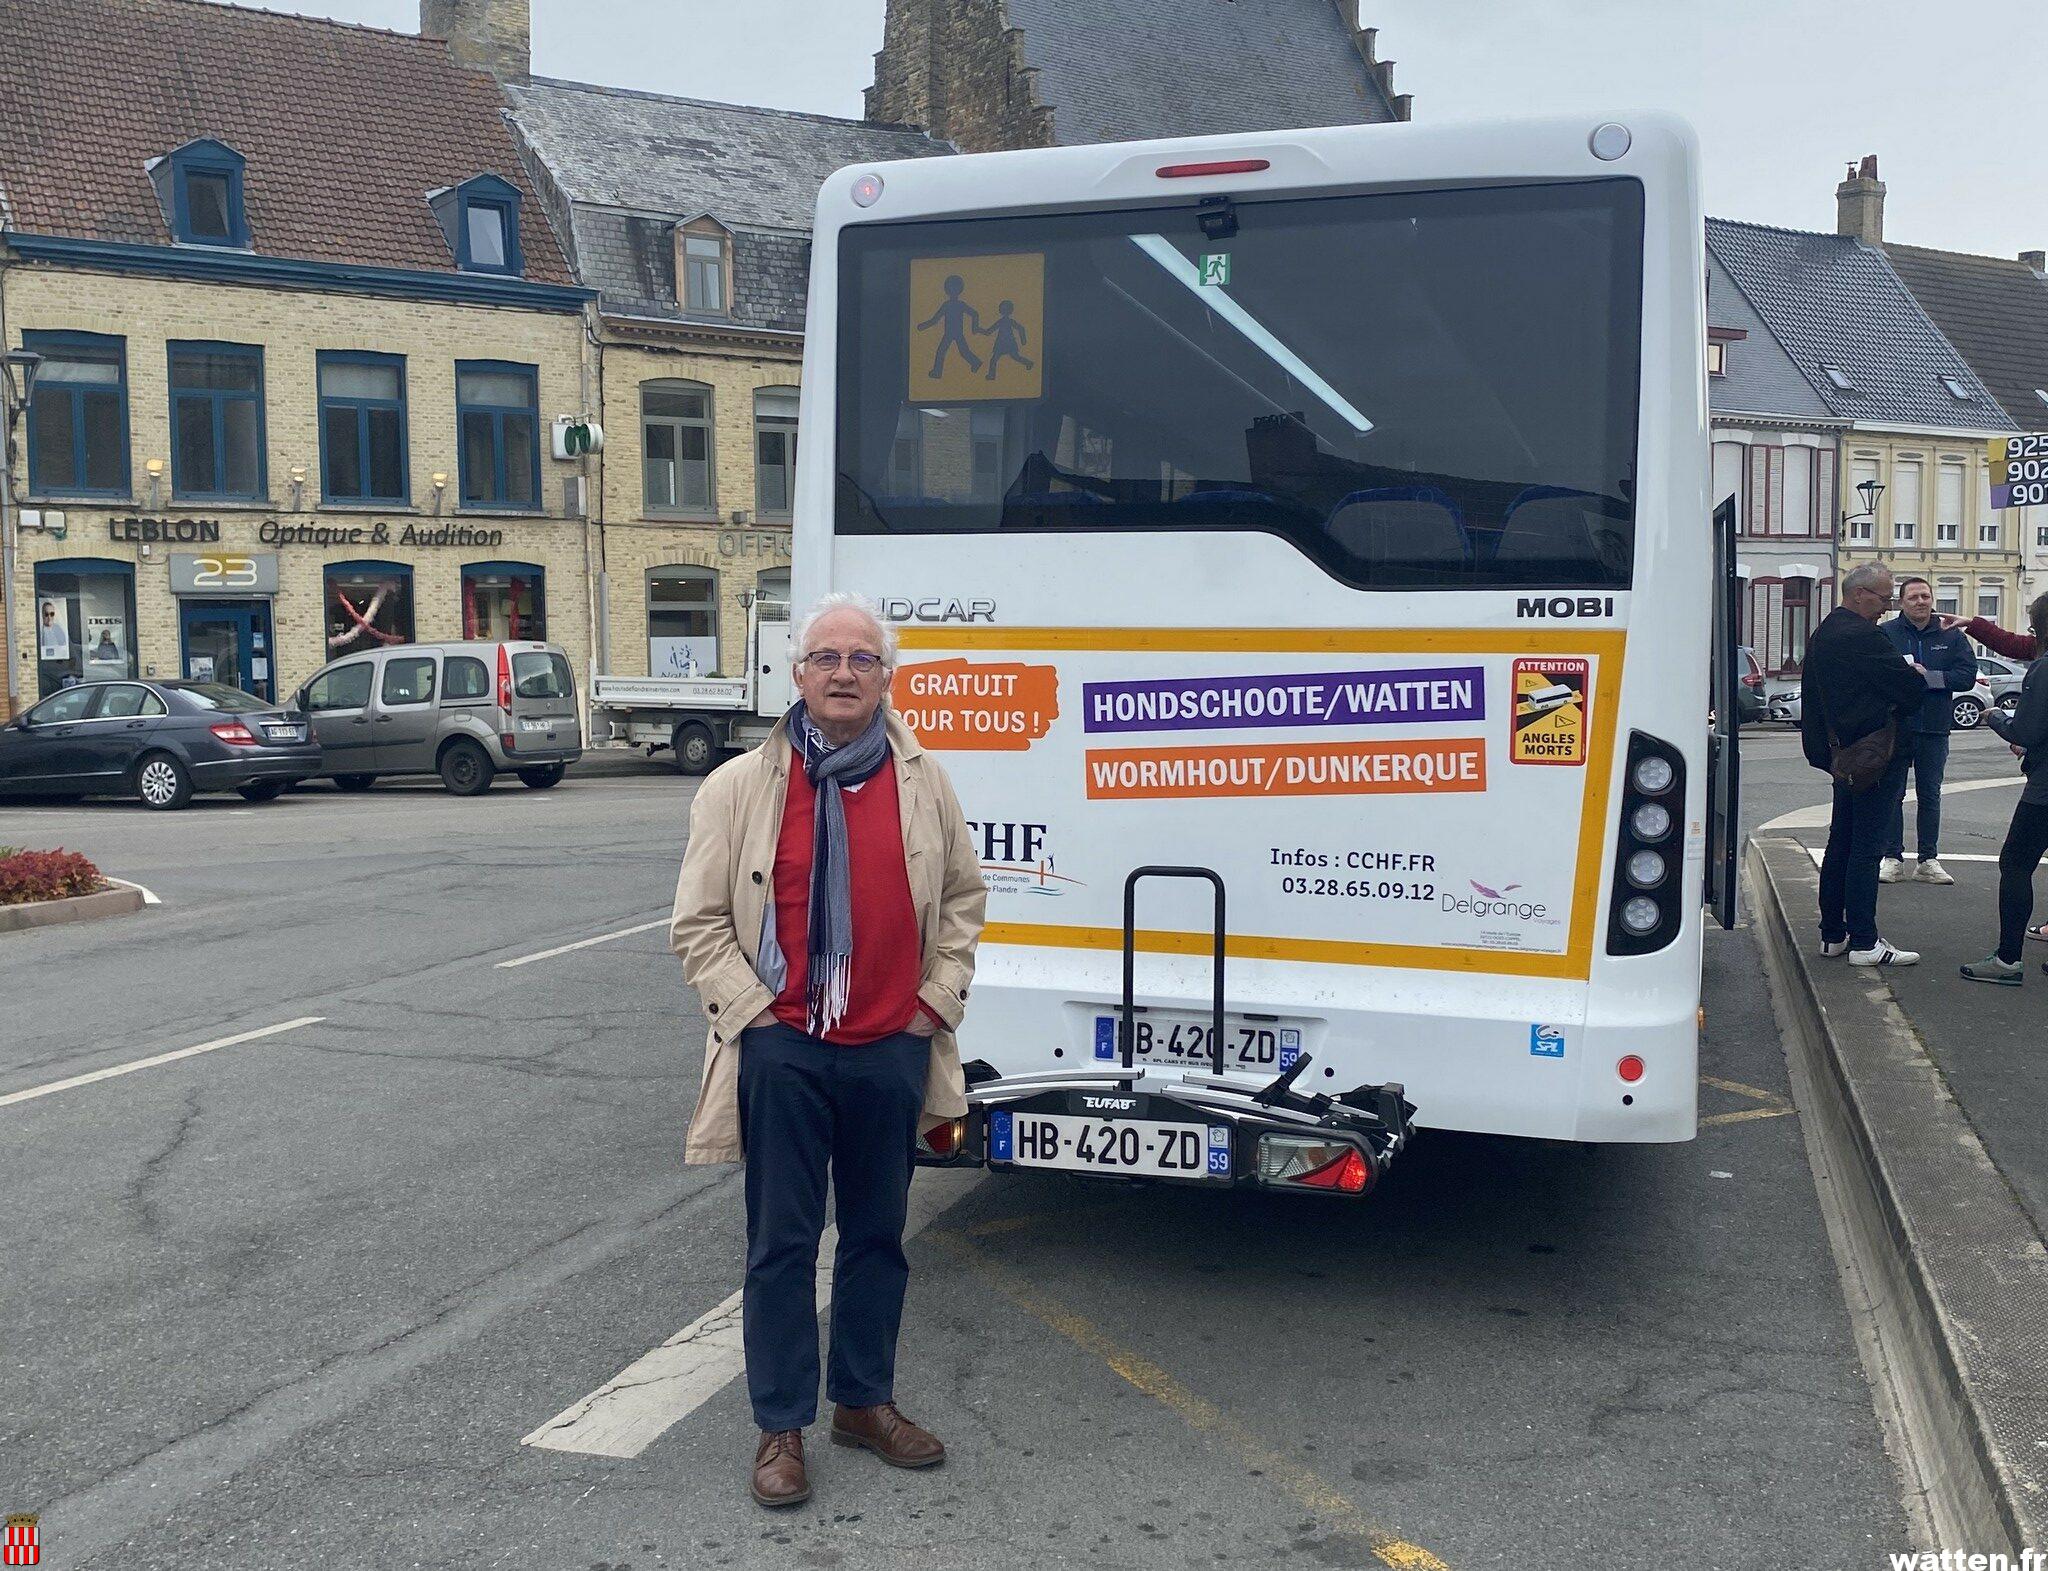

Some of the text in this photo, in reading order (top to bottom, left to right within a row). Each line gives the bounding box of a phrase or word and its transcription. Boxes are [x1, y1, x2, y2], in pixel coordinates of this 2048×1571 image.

[2008, 436, 2048, 458] 925
[2008, 459, 2048, 482] 902
[2012, 483, 2048, 505] 90
[109, 518, 219, 542] LEBLON
[259, 520, 502, 548] Optique & Audition
[193, 558, 257, 586] 23
[1517, 597, 1613, 618] MOBI
[1518, 661, 1585, 672] ATTENTION
[910, 673, 1018, 697] GRATUIT
[1094, 679, 1472, 722] HONDSCHOOTE/WATTEN
[960, 710, 1026, 733] TOUS
[1033, 711, 1039, 733] !
[1522, 733, 1575, 744] ANGLES
[1524, 745, 1572, 756] MORTS
[1092, 752, 1479, 791] WORMHOUT/DUNKERQUE
[966, 821, 1047, 862] HF
[1270, 848, 1328, 867] Infos
[1347, 851, 1435, 872] CCHF.FR
[992, 874, 1030, 882] Communes
[992, 886, 1018, 894] Flandre
[1282, 877, 1435, 901] 03.28.65.09.12
[1441, 893, 1546, 920] Delgrange
[1101, 1042, 1107, 1051] F
[1281, 1052, 1298, 1068] 59
[1082, 1097, 1133, 1110] EUFAB
[999, 1120, 1228, 1170] F HB-420-ZD 59
